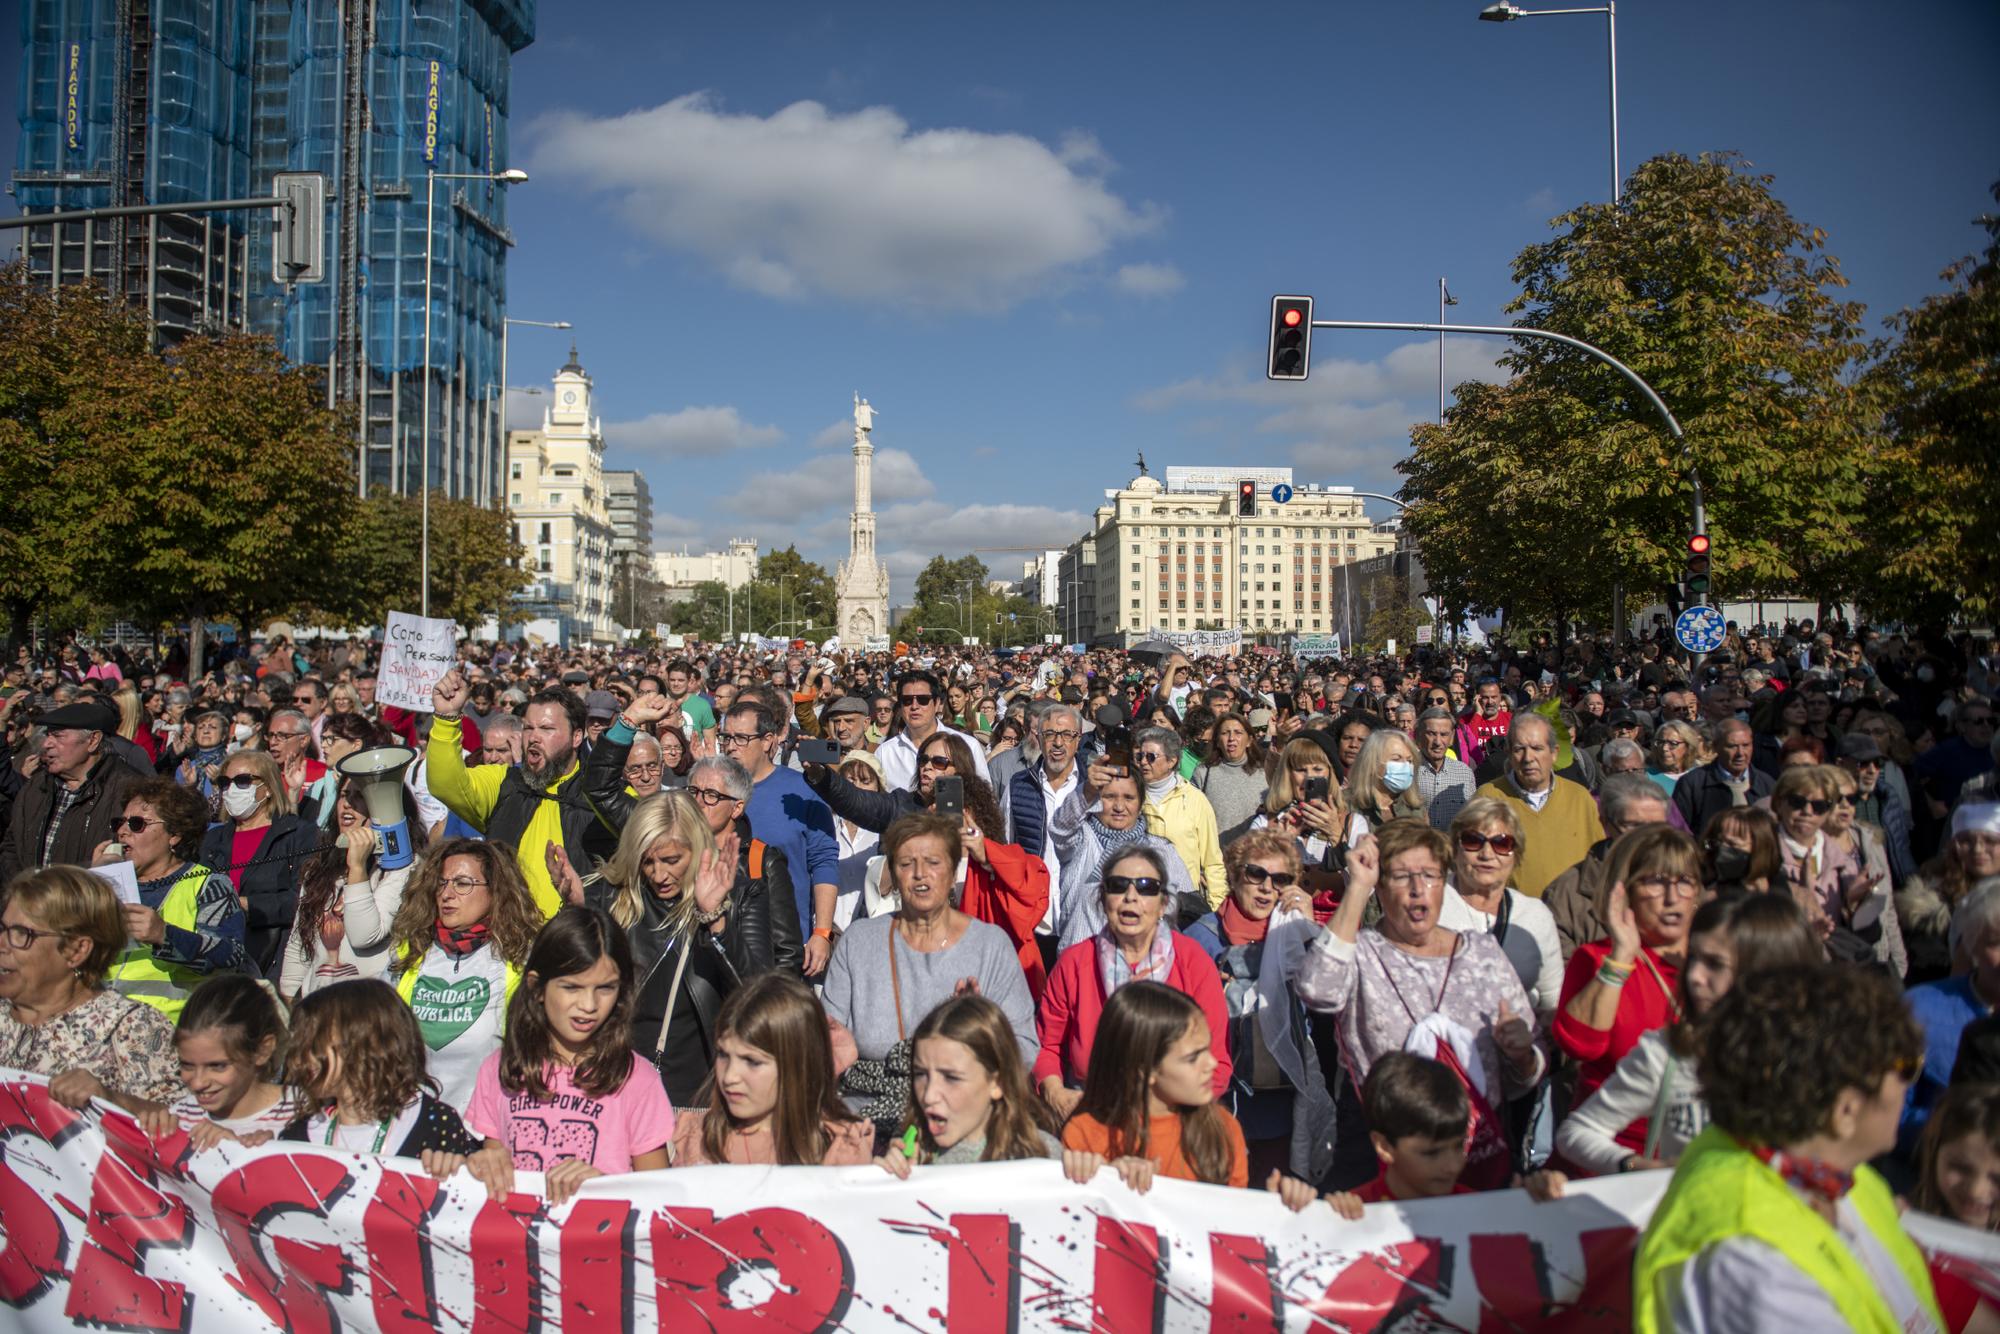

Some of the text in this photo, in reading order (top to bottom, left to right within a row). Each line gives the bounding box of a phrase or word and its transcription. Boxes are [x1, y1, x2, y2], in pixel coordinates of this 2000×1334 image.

[68, 44, 80, 148] DRAGADOS
[425, 60, 440, 161] DRAGADOS
[416, 988, 477, 1004] SANIDAD
[413, 1002, 474, 1022] PÚBLICA
[509, 1093, 604, 1119] GIRL POWER
